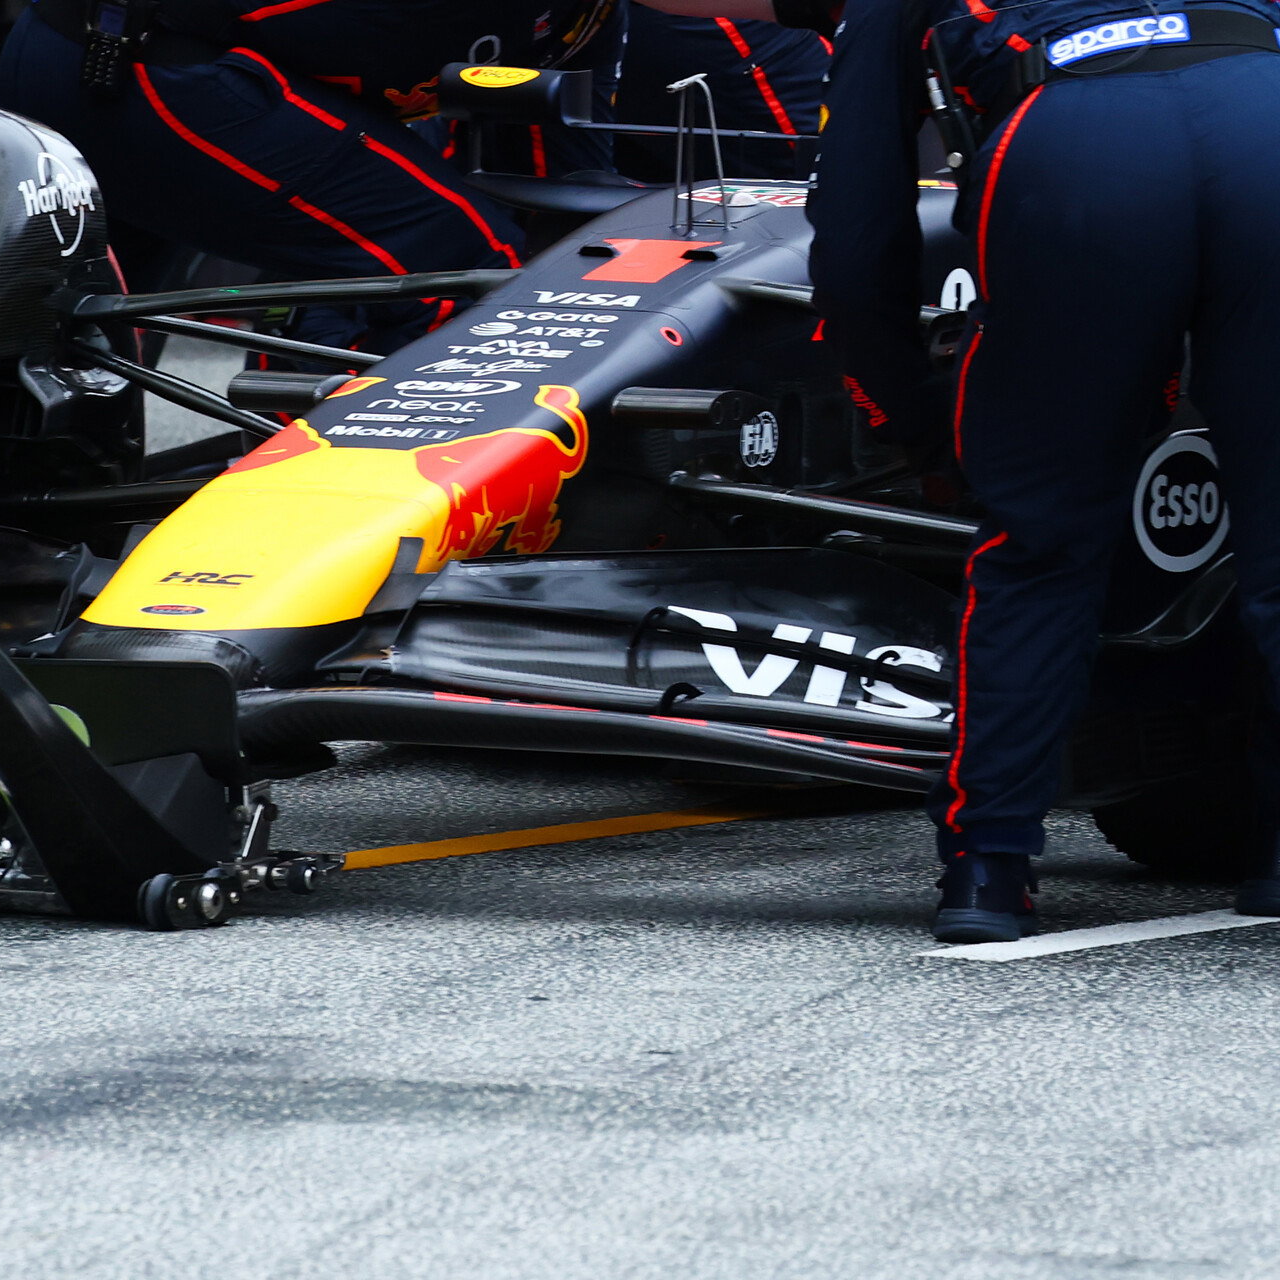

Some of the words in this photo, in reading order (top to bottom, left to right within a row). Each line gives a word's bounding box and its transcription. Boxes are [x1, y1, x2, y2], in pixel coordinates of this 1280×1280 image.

[1050, 15, 1186, 66] sparco
[533, 290, 641, 308] VISA
[516, 326, 610, 339] AT&T
[479, 339, 551, 350] AVA
[447, 345, 574, 359] TRADE
[394, 380, 496, 393] CDW
[366, 399, 486, 413] neat.
[324, 425, 423, 438] Mobil
[158, 572, 255, 585] HRC
[668, 605, 955, 722] VIS
